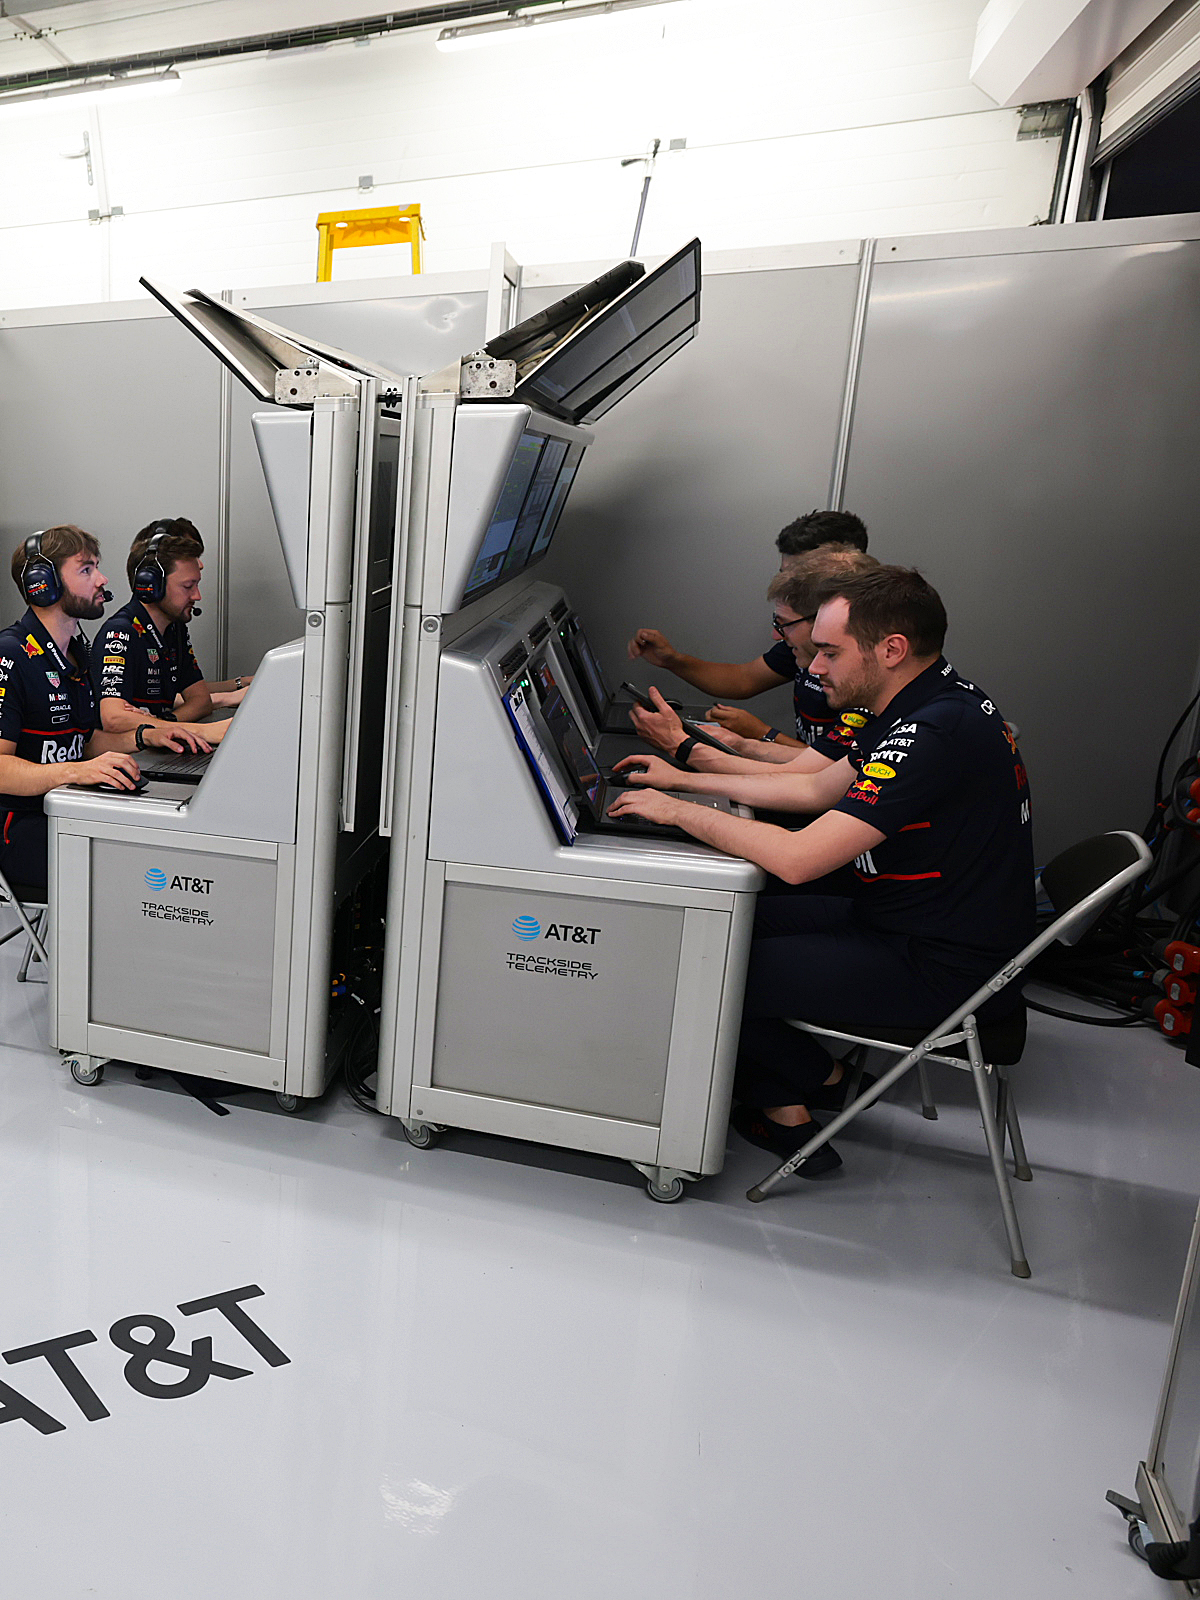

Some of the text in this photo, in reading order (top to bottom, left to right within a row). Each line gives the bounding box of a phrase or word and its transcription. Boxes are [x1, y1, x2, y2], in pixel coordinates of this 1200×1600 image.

[106, 631, 130, 641] Mobil
[102, 665, 125, 673] HRC
[886, 738, 915, 748] AT&T
[170, 875, 215, 895] AT&T
[141, 901, 210, 918] TRACKSIDE
[141, 909, 215, 927] TELEMETRY
[544, 922, 602, 945] AT&T
[506, 952, 593, 971] TRACKSIDE
[506, 961, 599, 981] TELEMETRY
